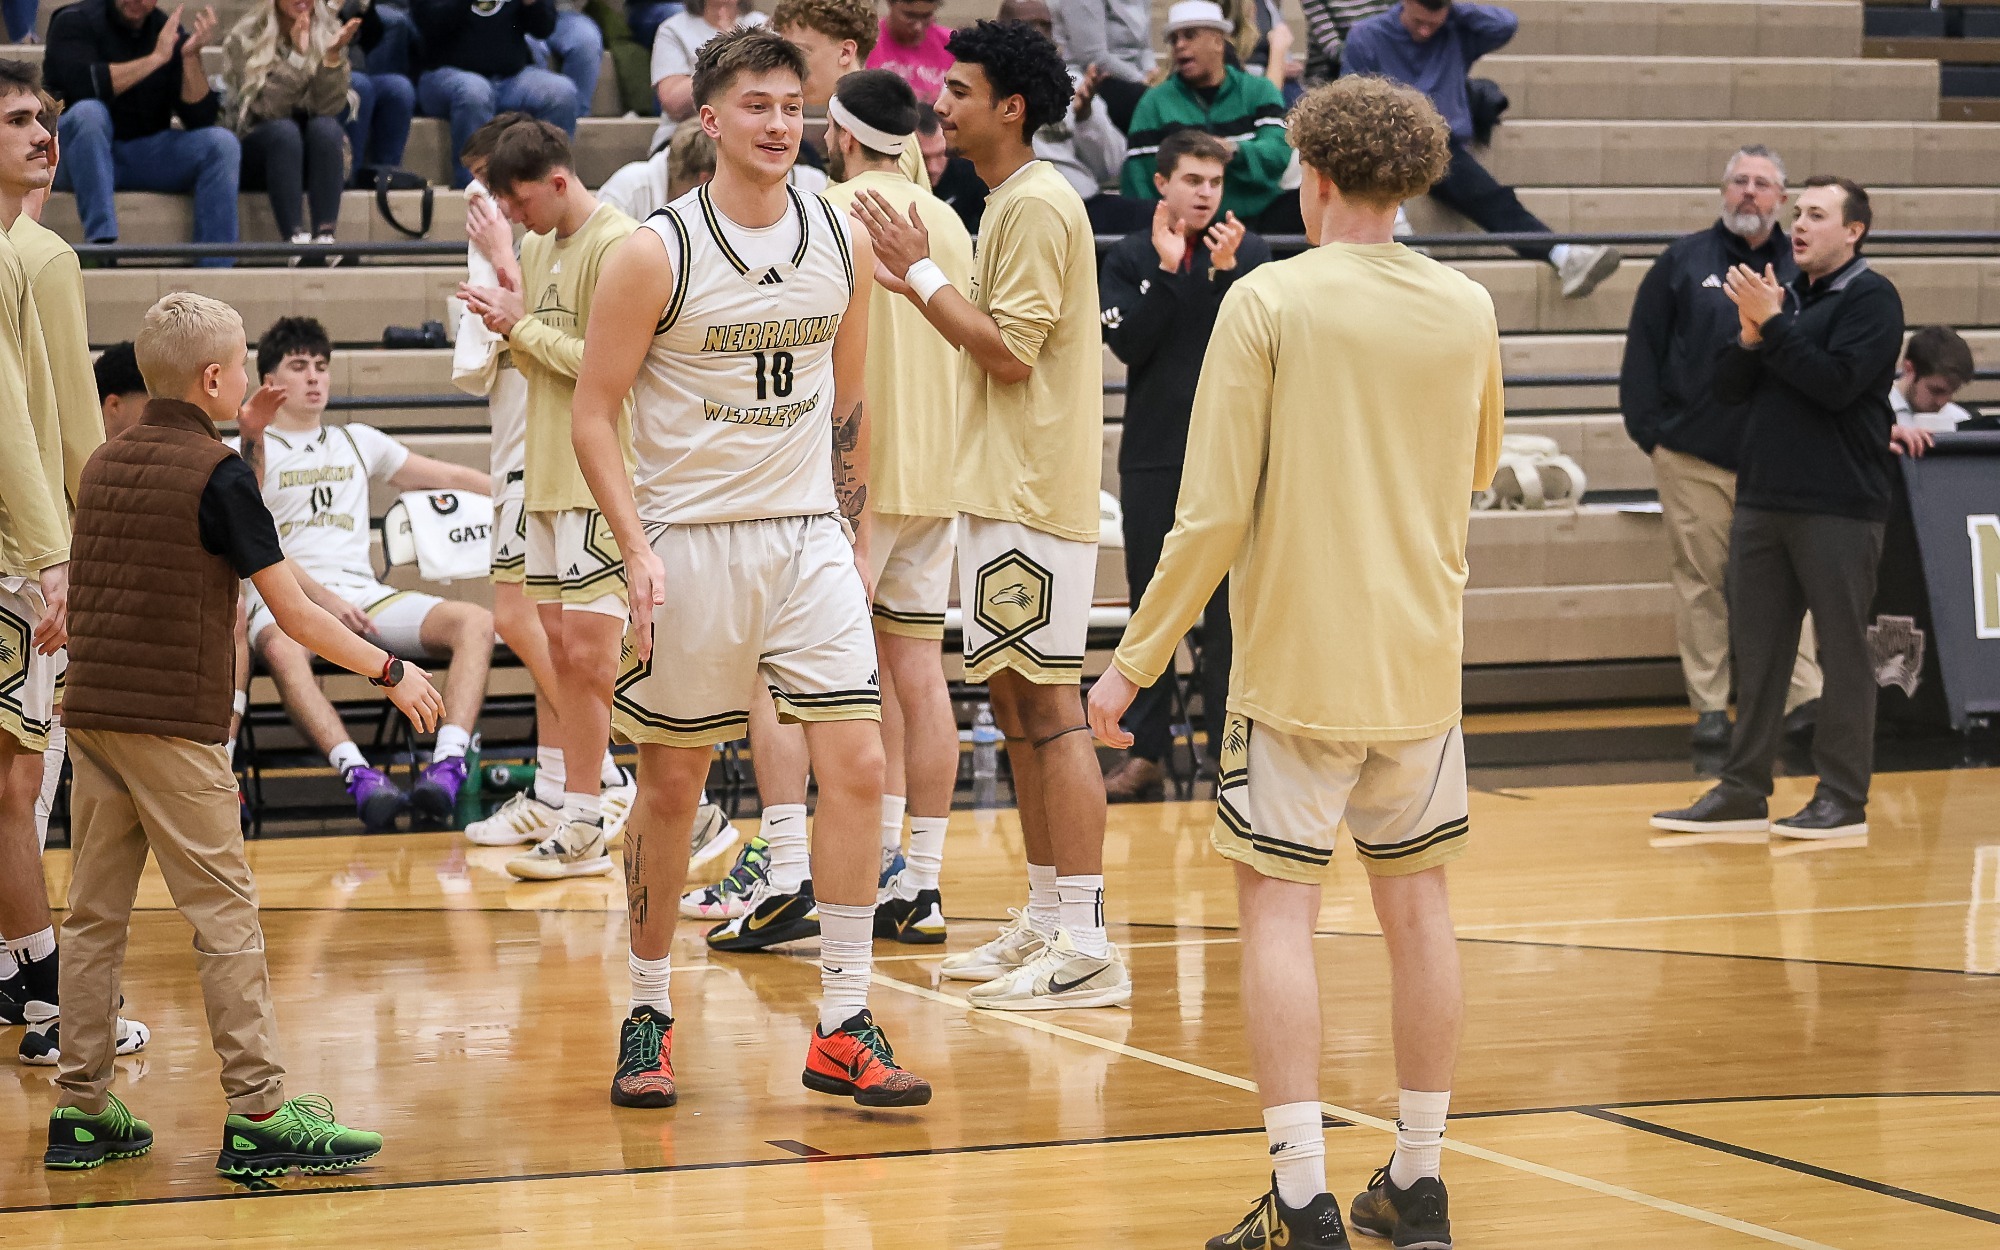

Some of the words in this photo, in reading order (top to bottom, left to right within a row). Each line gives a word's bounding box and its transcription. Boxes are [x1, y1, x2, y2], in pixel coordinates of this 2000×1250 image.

[701, 314, 839, 351] NEBRASKA
[752, 351, 794, 400] 10
[448, 524, 492, 543] GAT
